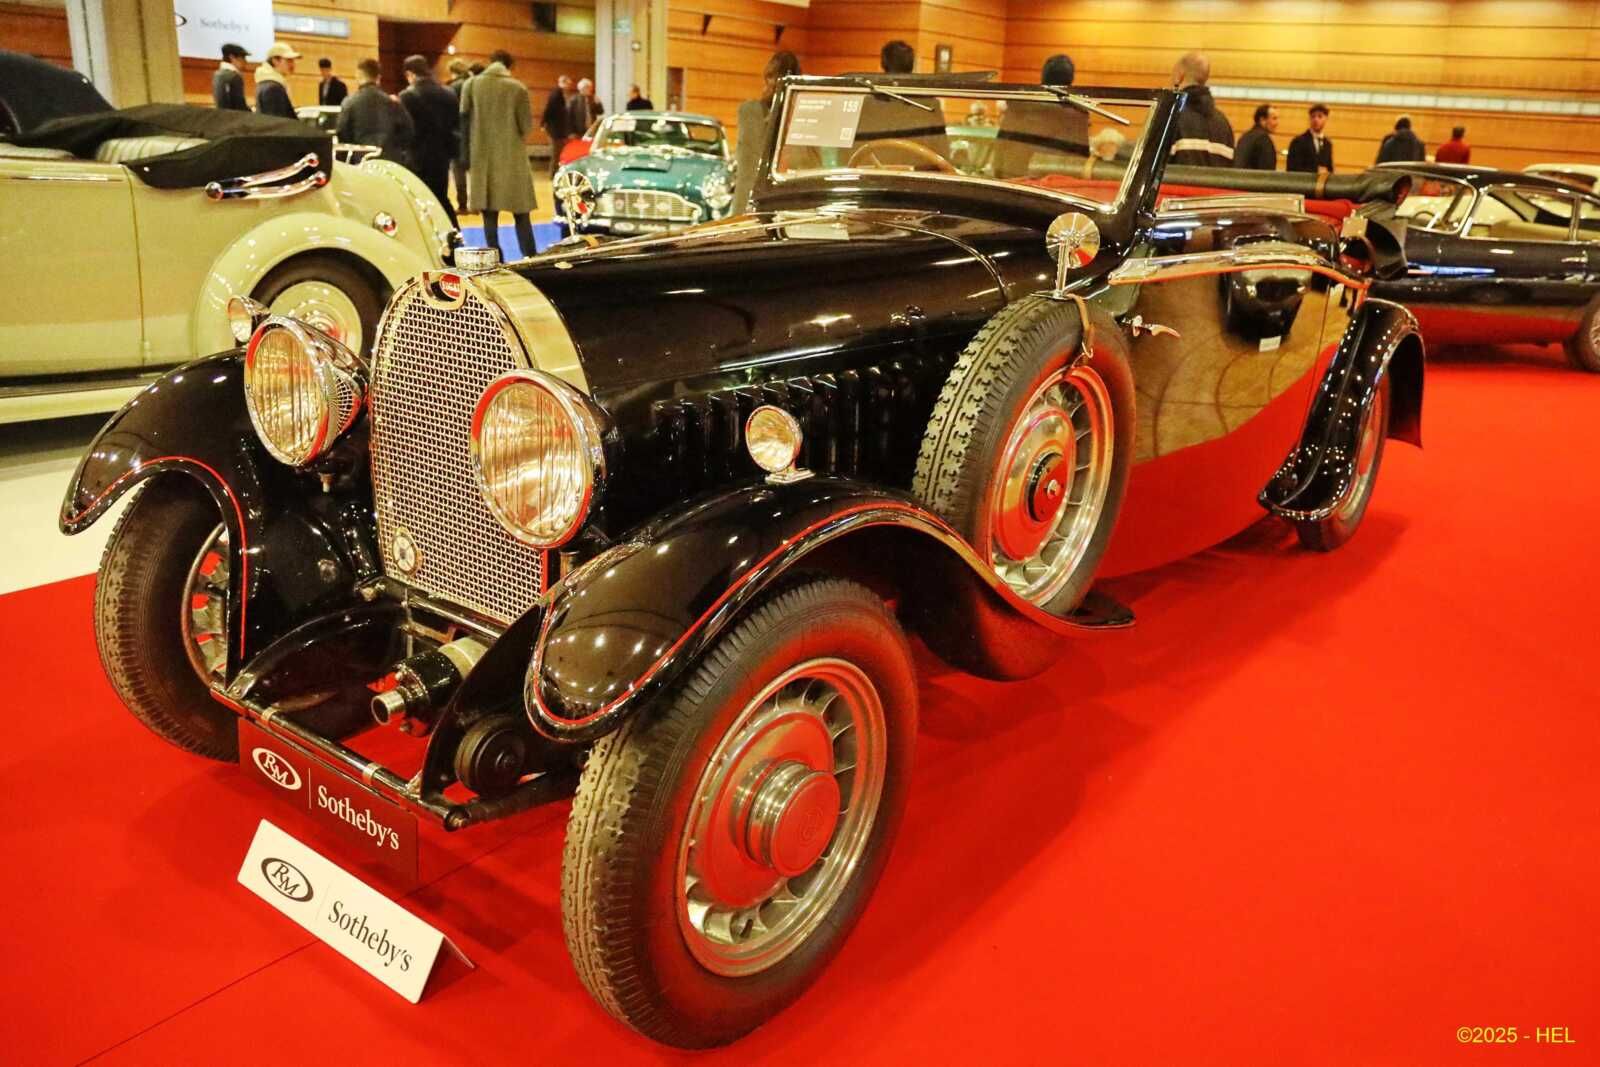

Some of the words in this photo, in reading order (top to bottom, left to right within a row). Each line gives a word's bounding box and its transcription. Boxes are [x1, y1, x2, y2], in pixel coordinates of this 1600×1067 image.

[263, 752, 290, 786] RM
[317, 785, 400, 850] Sotheby's
[271, 863, 301, 897] RM
[327, 900, 413, 972] Sotheby's
